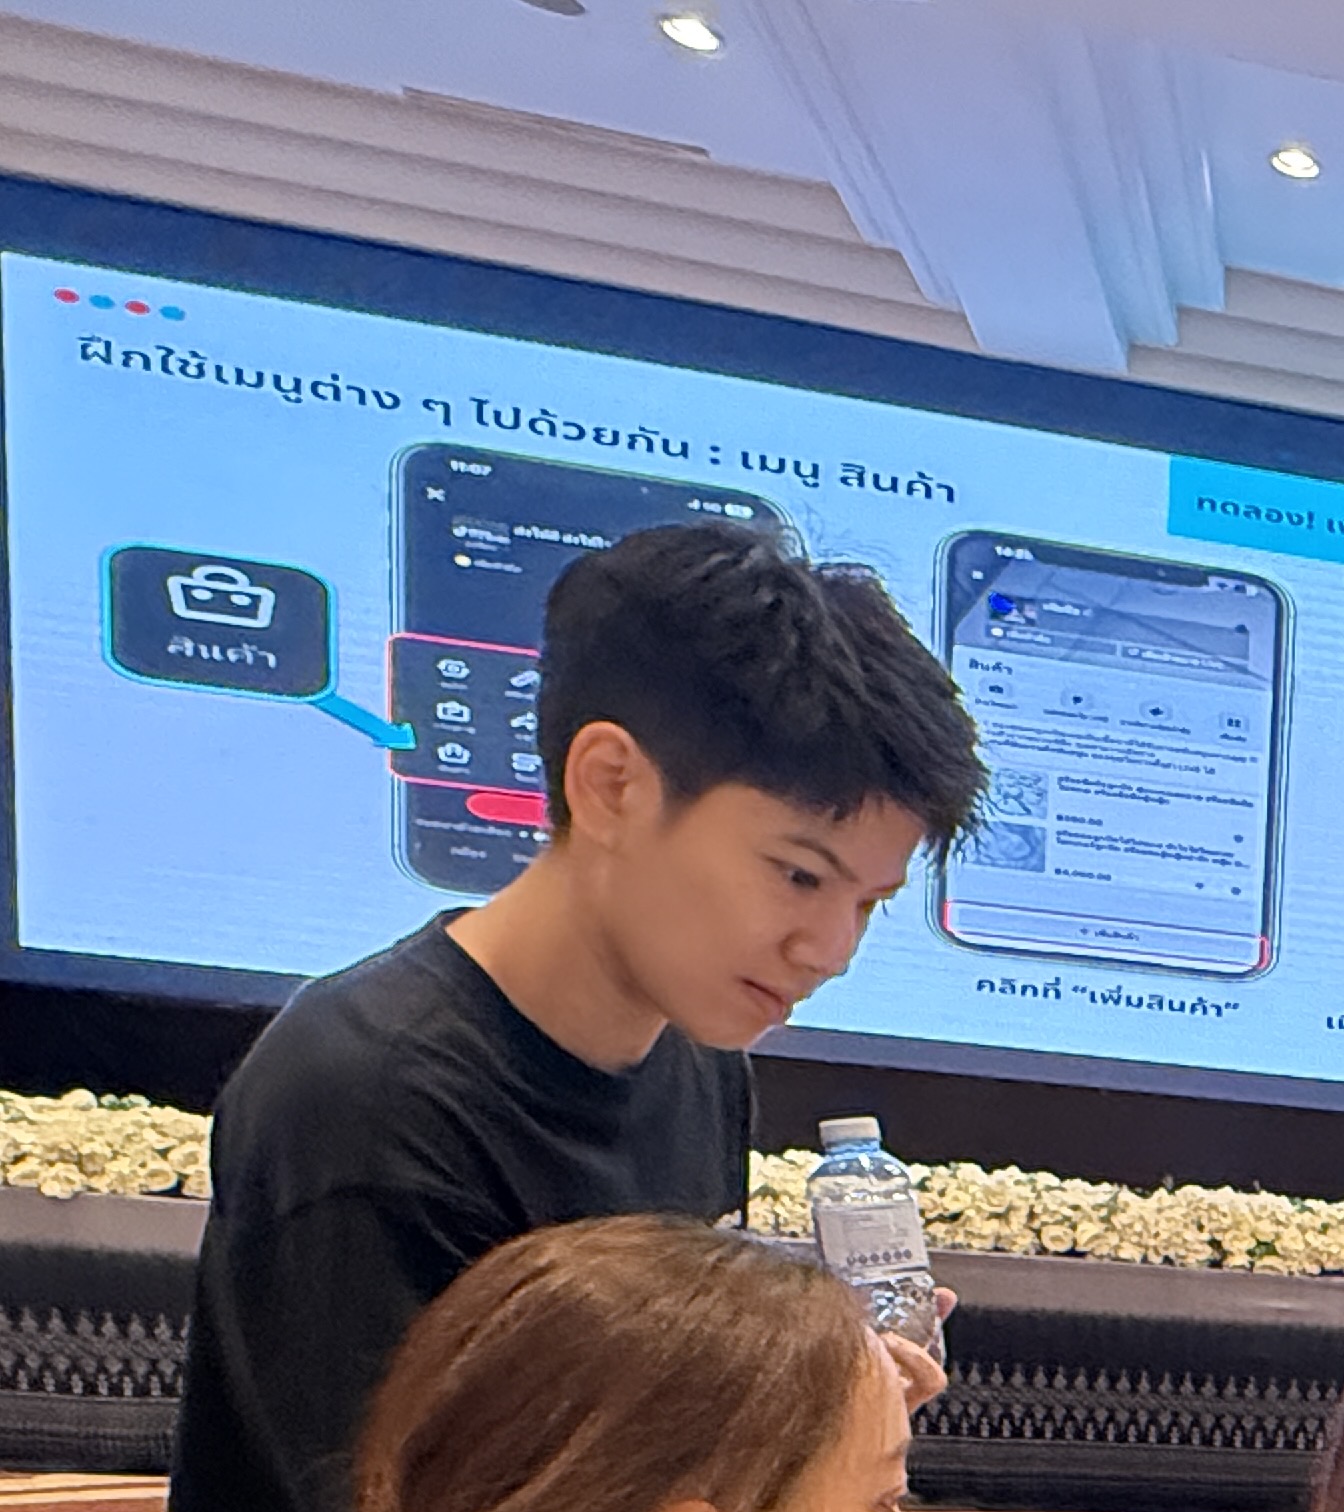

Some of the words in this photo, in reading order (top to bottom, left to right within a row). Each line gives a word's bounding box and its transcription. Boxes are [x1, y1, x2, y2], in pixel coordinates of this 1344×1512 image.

[76, 335, 401, 410] ฝึกใช้เมนูต่าง
[421, 397, 452, 427] ๆ
[470, 397, 690, 461] ไปด้วยกัน
[740, 449, 821, 488] เมนู
[839, 462, 957, 503] สินค้า
[1196, 496, 1315, 530] ทดลอง!
[167, 635, 277, 669] สินค้า
[976, 976, 1062, 1000] คลิกที่
